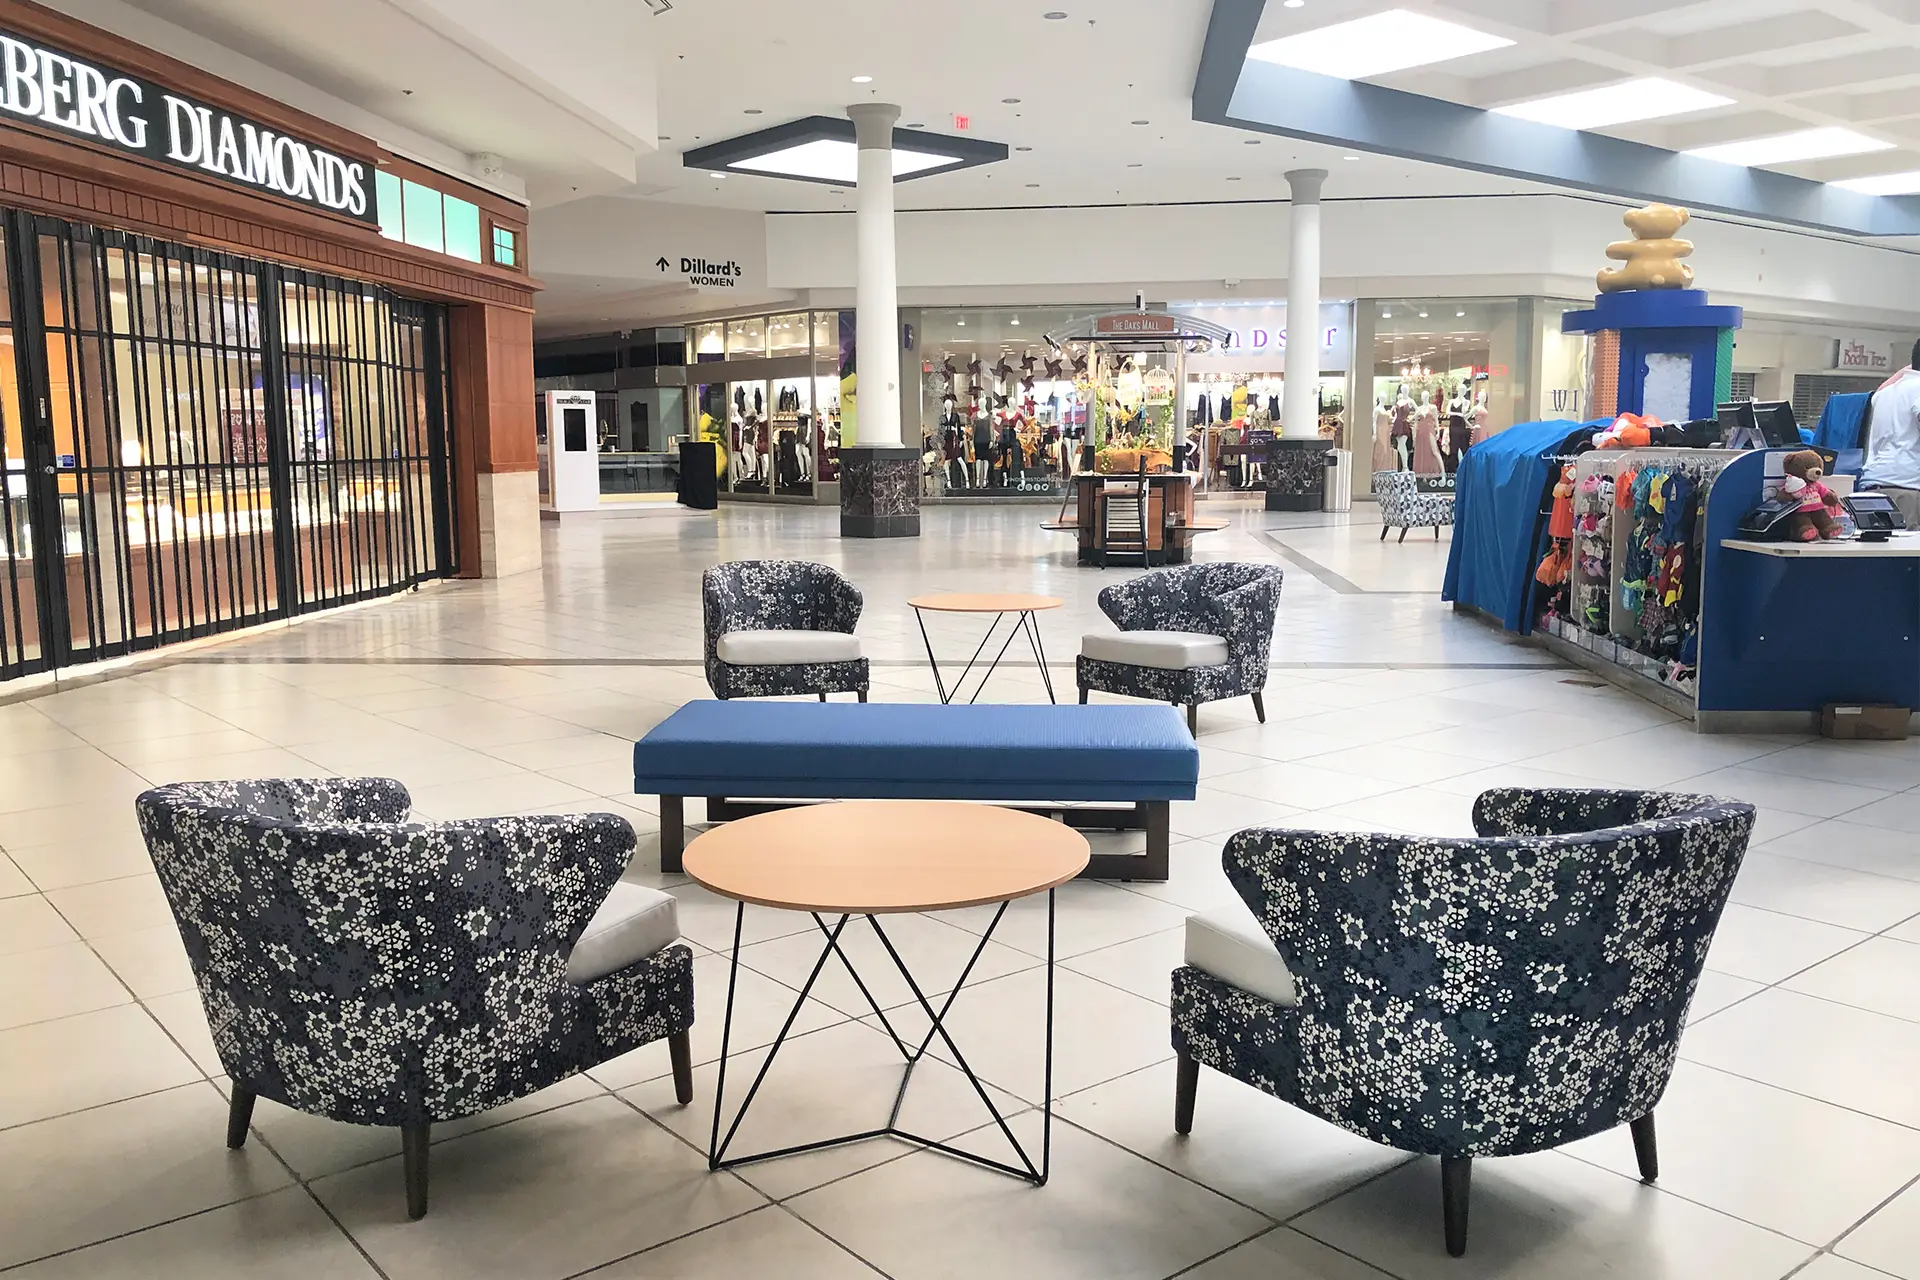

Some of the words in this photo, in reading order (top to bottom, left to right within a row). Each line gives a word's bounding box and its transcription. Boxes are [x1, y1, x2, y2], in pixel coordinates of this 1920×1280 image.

[0, 35, 149, 148] BERG
[162, 94, 366, 215] DIAMONDS
[956, 116, 968, 129] EXIT
[680, 258, 741, 276] Dillard's
[690, 276, 734, 286] WOMEN
